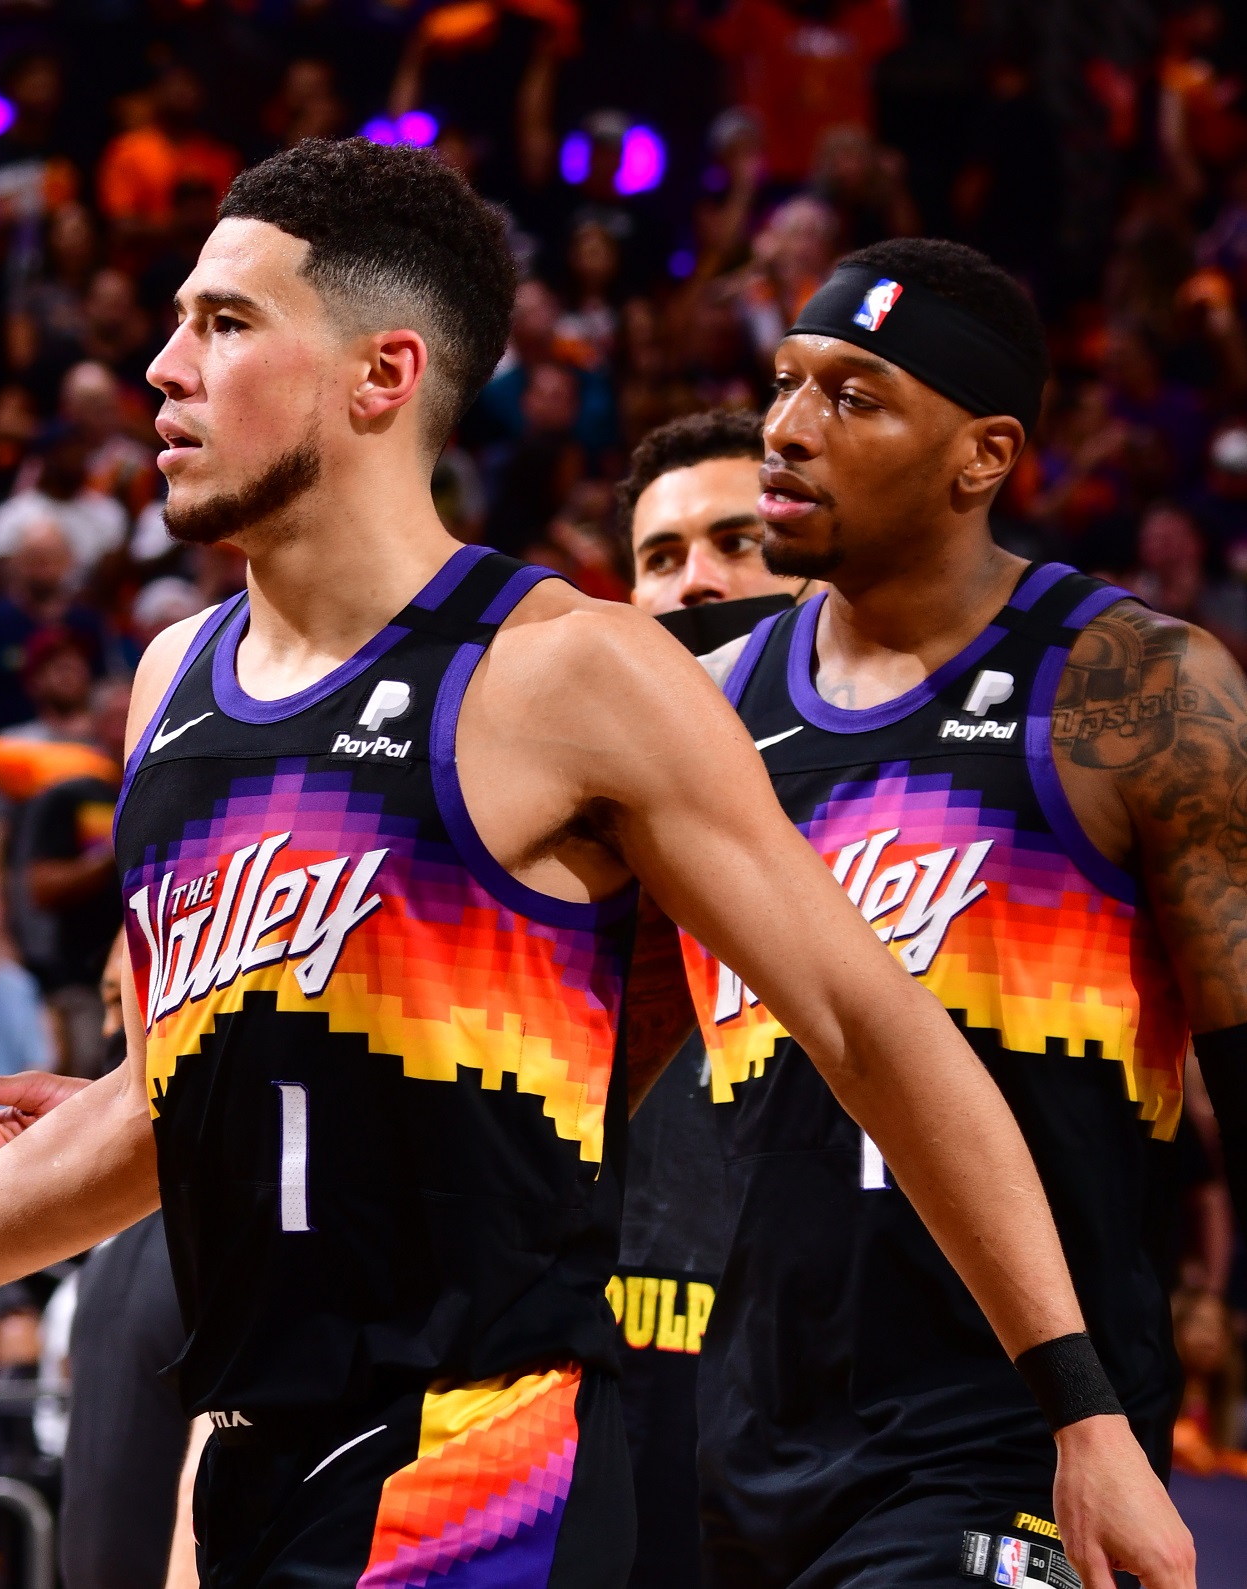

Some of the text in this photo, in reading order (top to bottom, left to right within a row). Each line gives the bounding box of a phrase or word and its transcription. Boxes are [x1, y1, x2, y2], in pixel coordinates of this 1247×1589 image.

[939, 720, 1017, 741] PayPal
[331, 734, 412, 758] PayPal
[172, 870, 218, 916] THE
[128, 830, 391, 1036] Valley
[272, 1079, 315, 1233] 1
[1015, 1511, 1061, 1541] PHOE
[1031, 1557, 1045, 1569] 50
